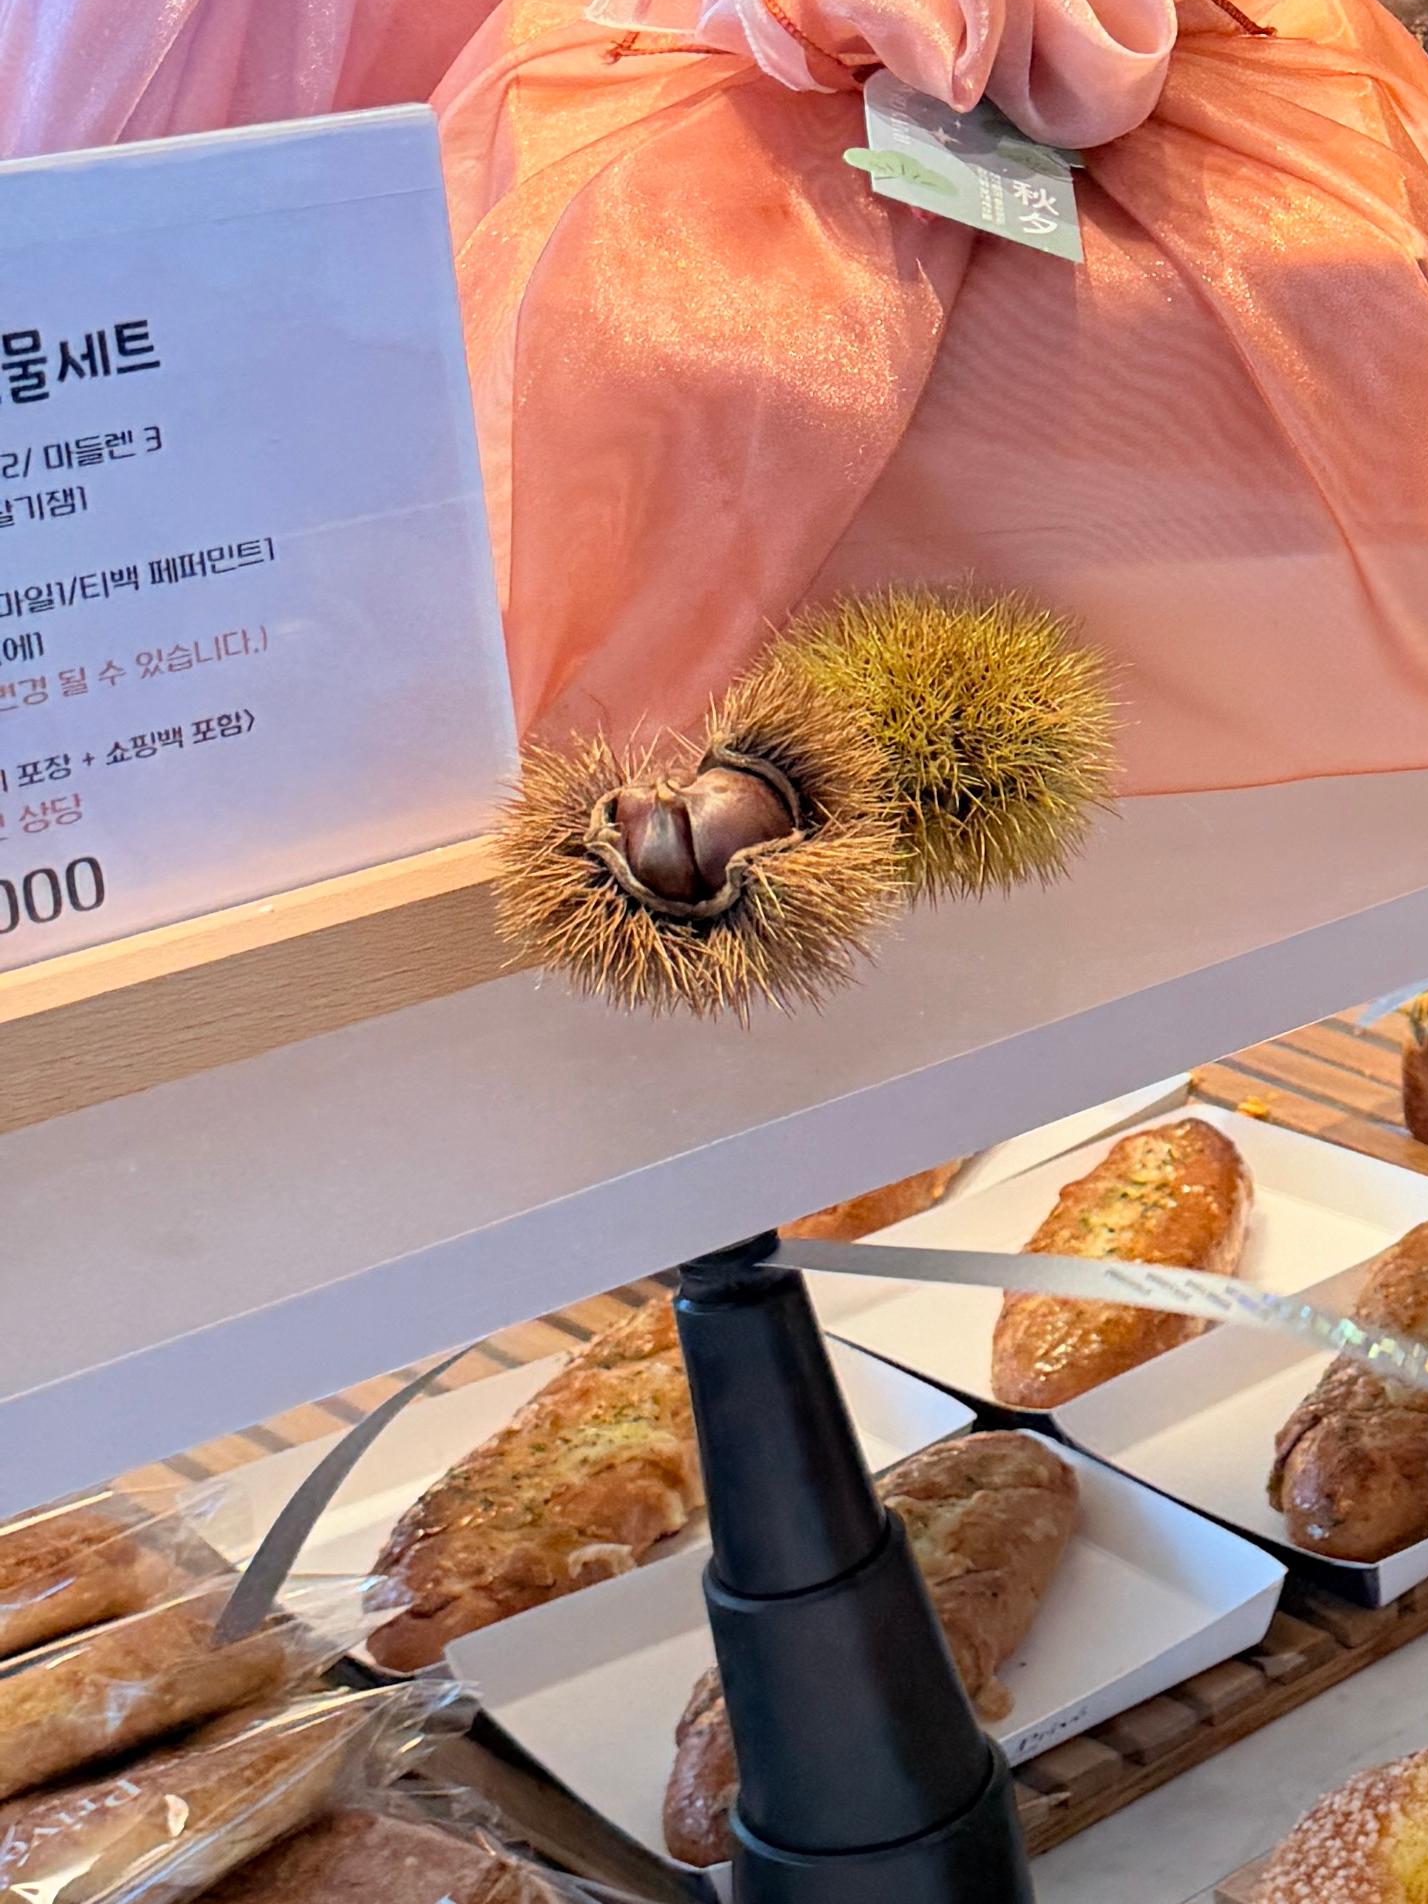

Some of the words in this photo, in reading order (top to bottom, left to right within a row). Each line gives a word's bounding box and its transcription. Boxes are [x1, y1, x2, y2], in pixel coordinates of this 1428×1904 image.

[1012, 179, 1060, 234] 秋夕
[0, 319, 161, 404] 물세트
[43, 429, 136, 470] 마들렌
[143, 425, 163, 453] 3
[148, 537, 276, 586] 페퍼민트1
[58, 666, 89, 697] 될
[98, 659, 127, 687] 수
[135, 625, 268, 679] 있습니다.)
[17, 753, 72, 787] 포장
[82, 752, 95, 767] +
[105, 725, 184, 765] 쇼핑백
[19, 793, 83, 834] 상당
